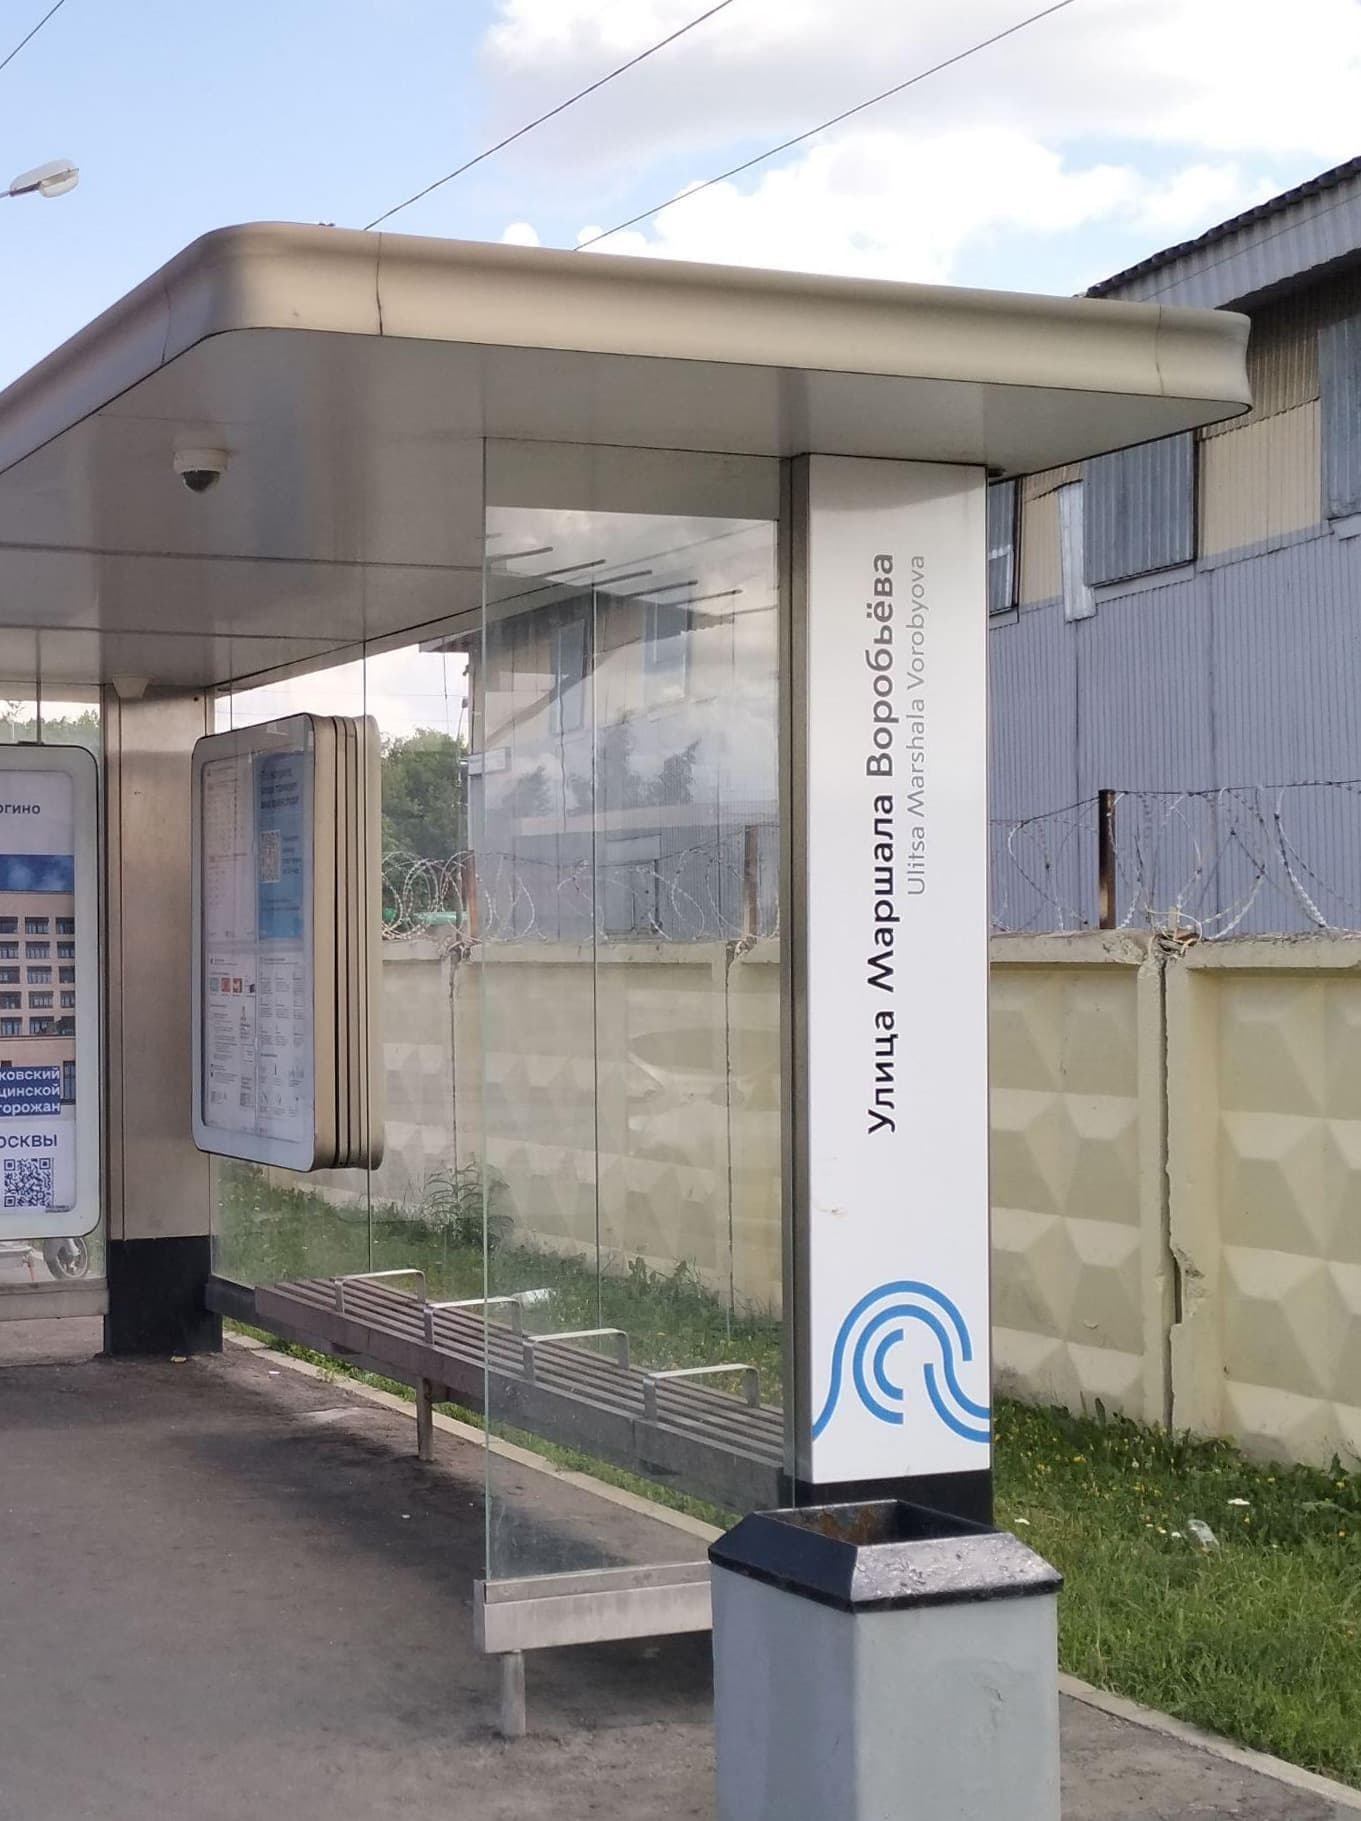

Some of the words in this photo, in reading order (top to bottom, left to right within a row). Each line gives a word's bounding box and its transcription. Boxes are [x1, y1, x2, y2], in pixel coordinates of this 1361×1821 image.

[865, 553, 899, 777] Воробьёва
[905, 555, 929, 690] Vorobyova
[906, 699, 926, 817] Marshala
[867, 794, 900, 993] Маршала
[907, 826, 926, 895] Ulitsa
[867, 1008, 899, 1134] Улица
